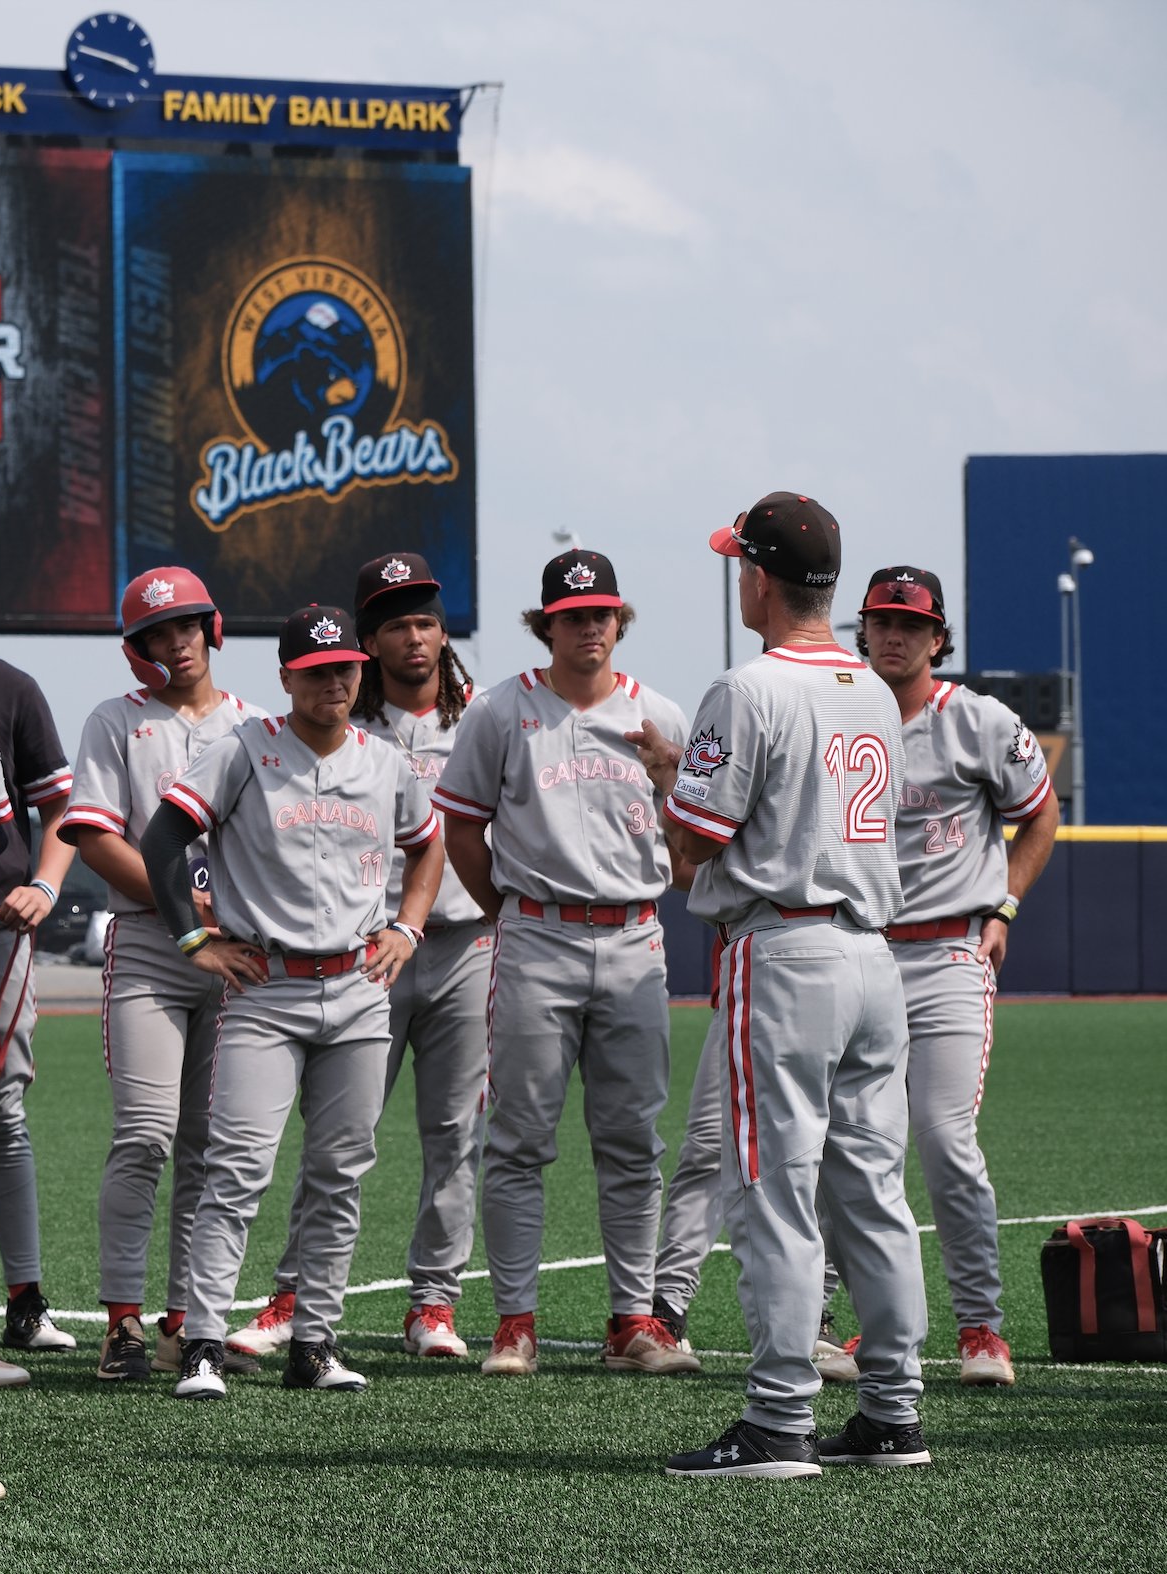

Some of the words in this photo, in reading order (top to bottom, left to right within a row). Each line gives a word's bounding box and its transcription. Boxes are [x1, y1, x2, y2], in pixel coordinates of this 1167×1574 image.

[164, 90, 276, 124] FAMILY
[289, 96, 451, 131] BALLPARK
[130, 245, 174, 367] WEST
[241, 279, 286, 333] WEST
[296, 271, 389, 340] VIRGINIA
[538, 757, 644, 790] CANADA
[677, 779, 705, 798] Canada
[824, 733, 889, 842] 12
[276, 801, 378, 840] CANADA
[925, 815, 965, 854] 24
[360, 851, 384, 887] 11
